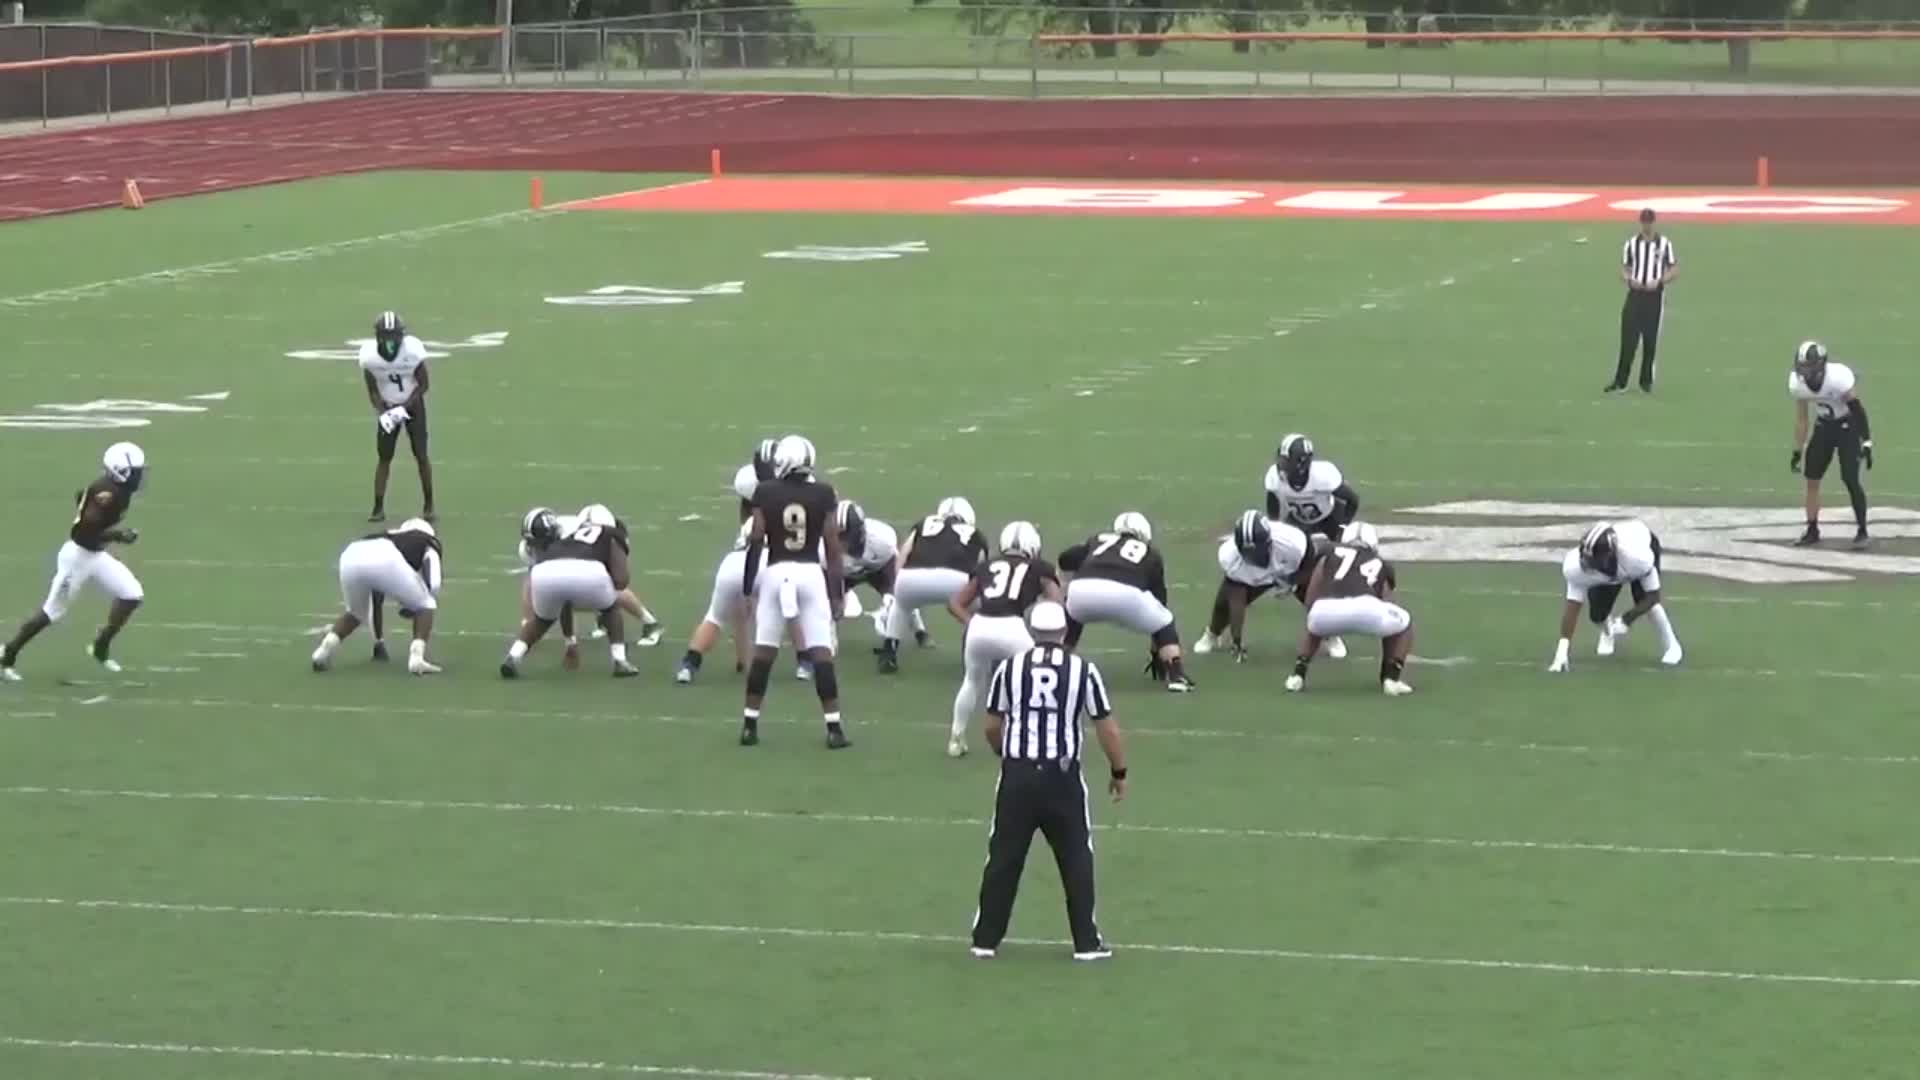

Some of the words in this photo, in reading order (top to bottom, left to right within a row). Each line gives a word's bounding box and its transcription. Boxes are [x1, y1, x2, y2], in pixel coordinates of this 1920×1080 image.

[388, 374, 404, 392] 4
[783, 502, 807, 551] 9
[1092, 532, 1148, 564] 78
[1333, 546, 1383, 587] 74
[983, 560, 1029, 600] 31
[1028, 667, 1059, 708] R
